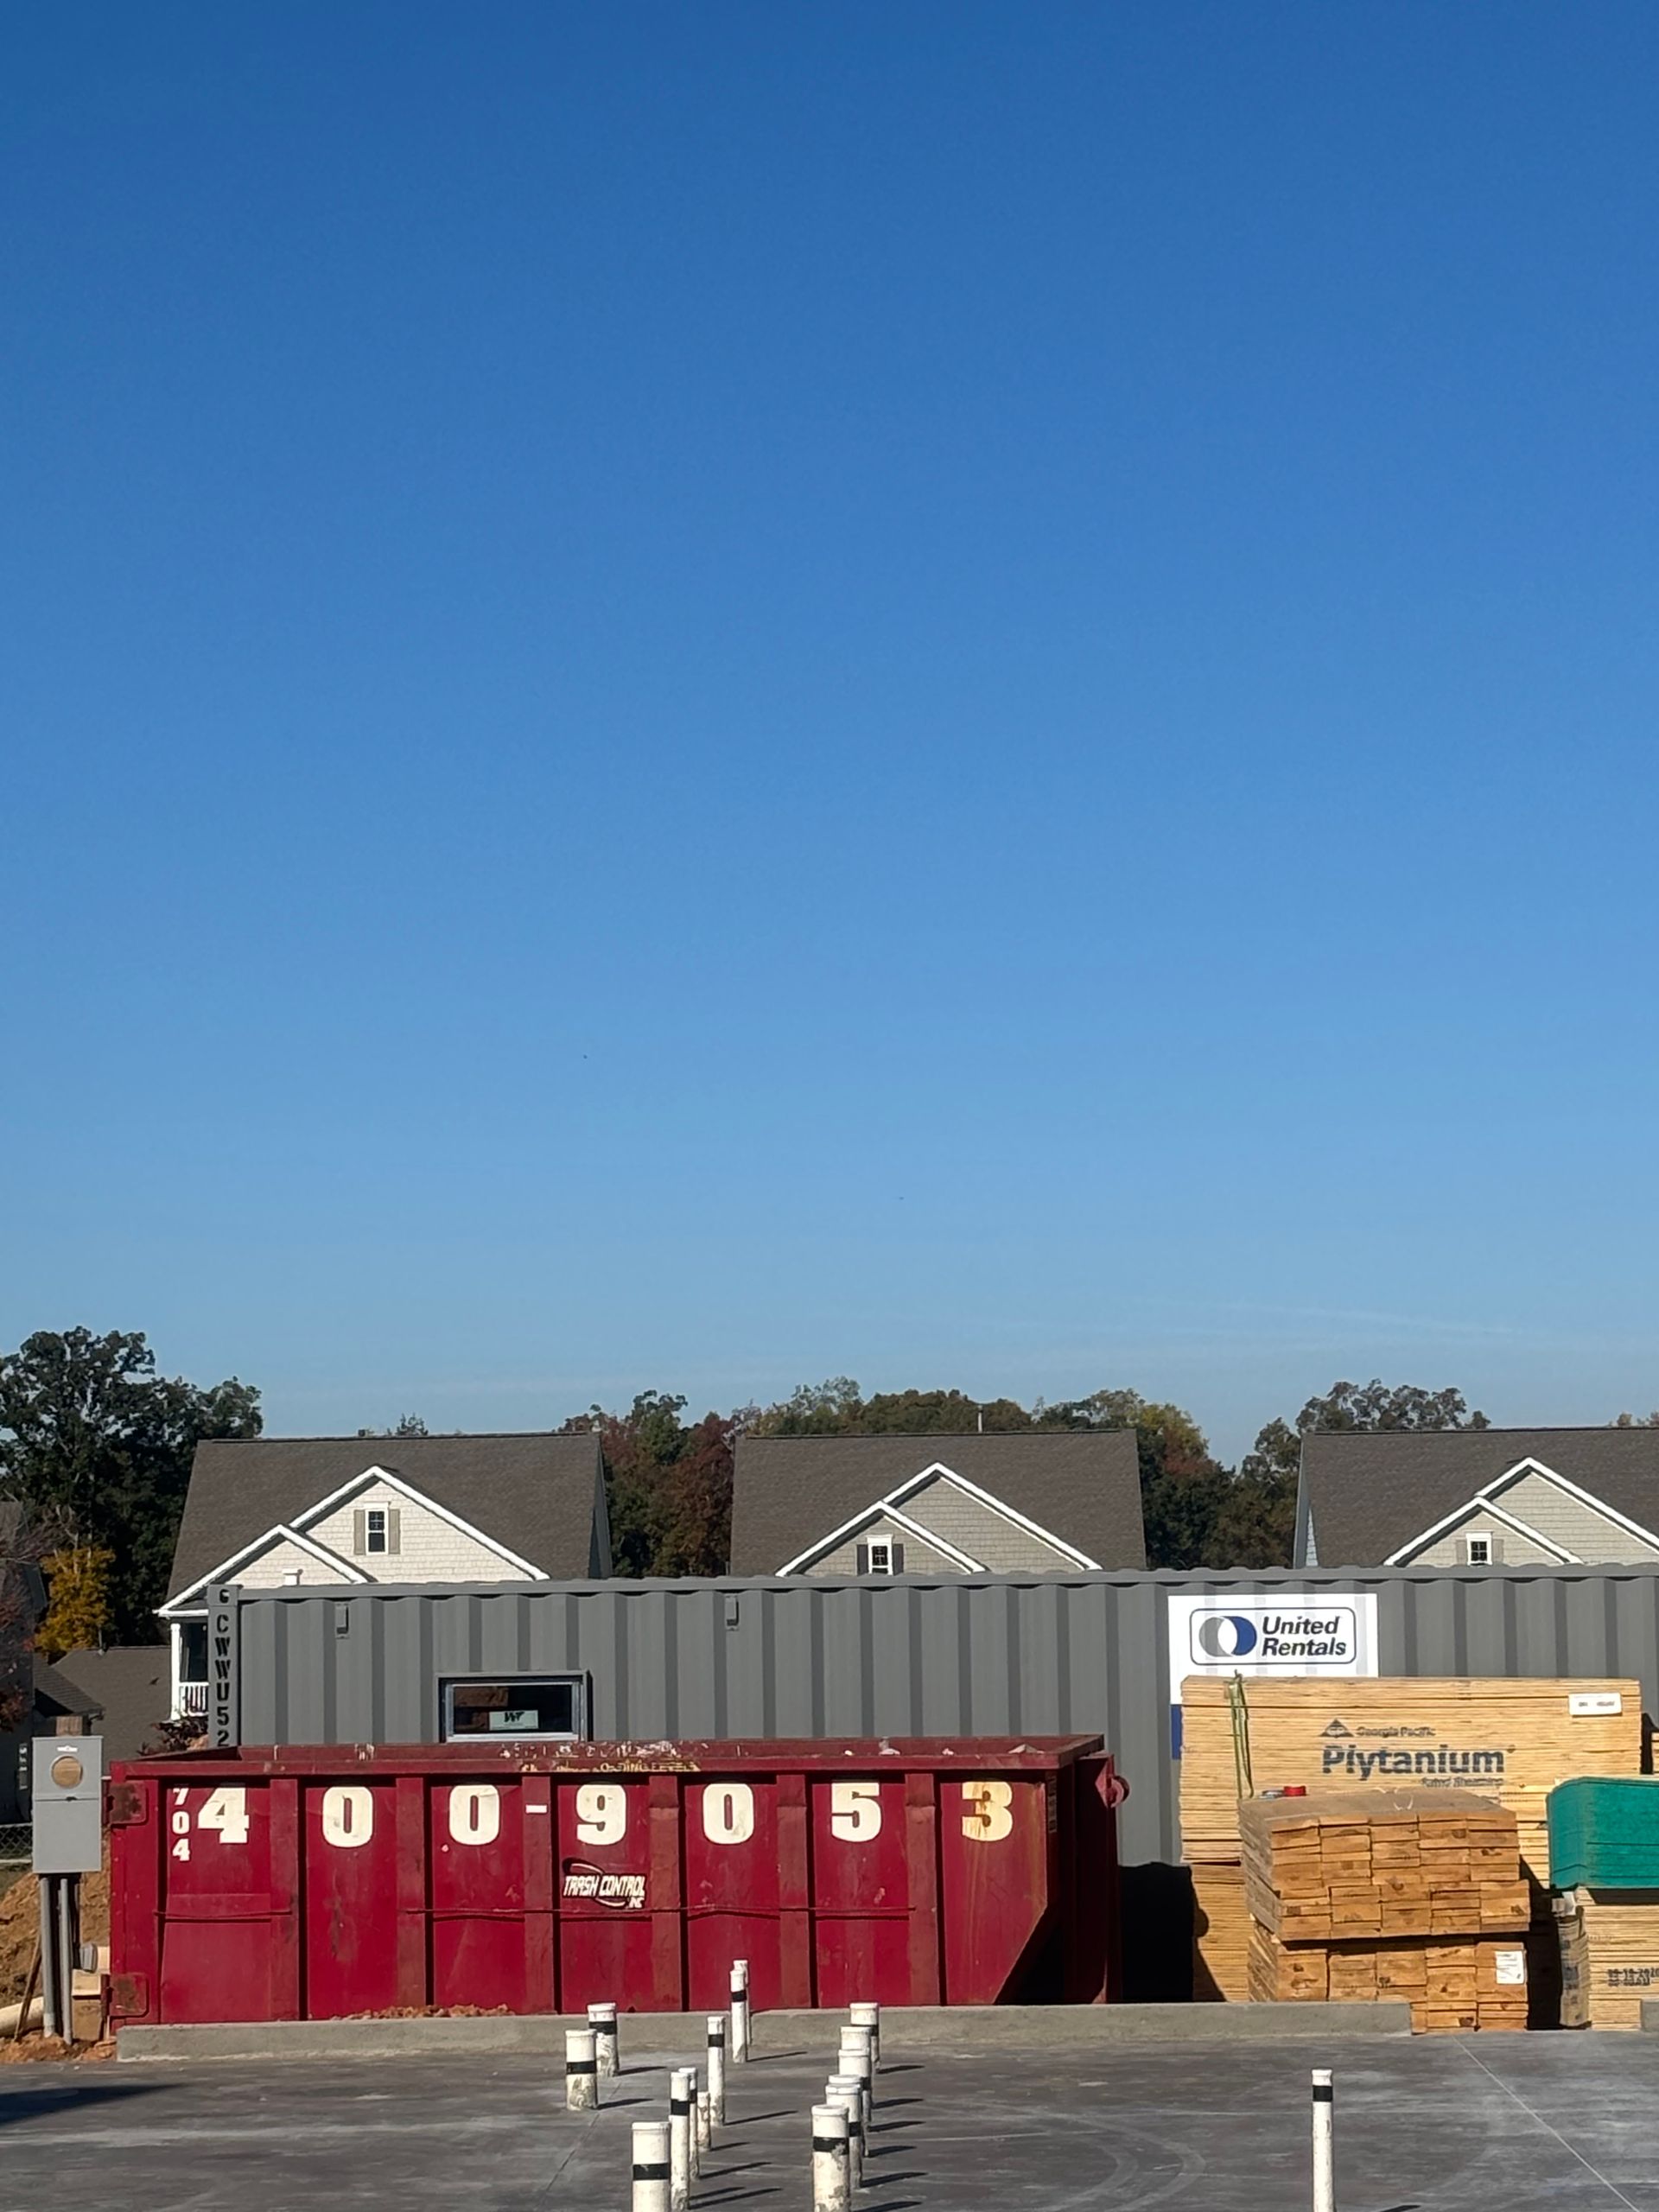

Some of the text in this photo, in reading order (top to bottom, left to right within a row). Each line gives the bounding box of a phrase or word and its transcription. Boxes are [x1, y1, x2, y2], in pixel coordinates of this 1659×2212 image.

[1263, 1616, 1340, 1634] United
[1262, 1637, 1346, 1656] Rentals
[1322, 1744, 1503, 1781] Plytanium
[563, 1875, 645, 1896] TRASH CONTROL
